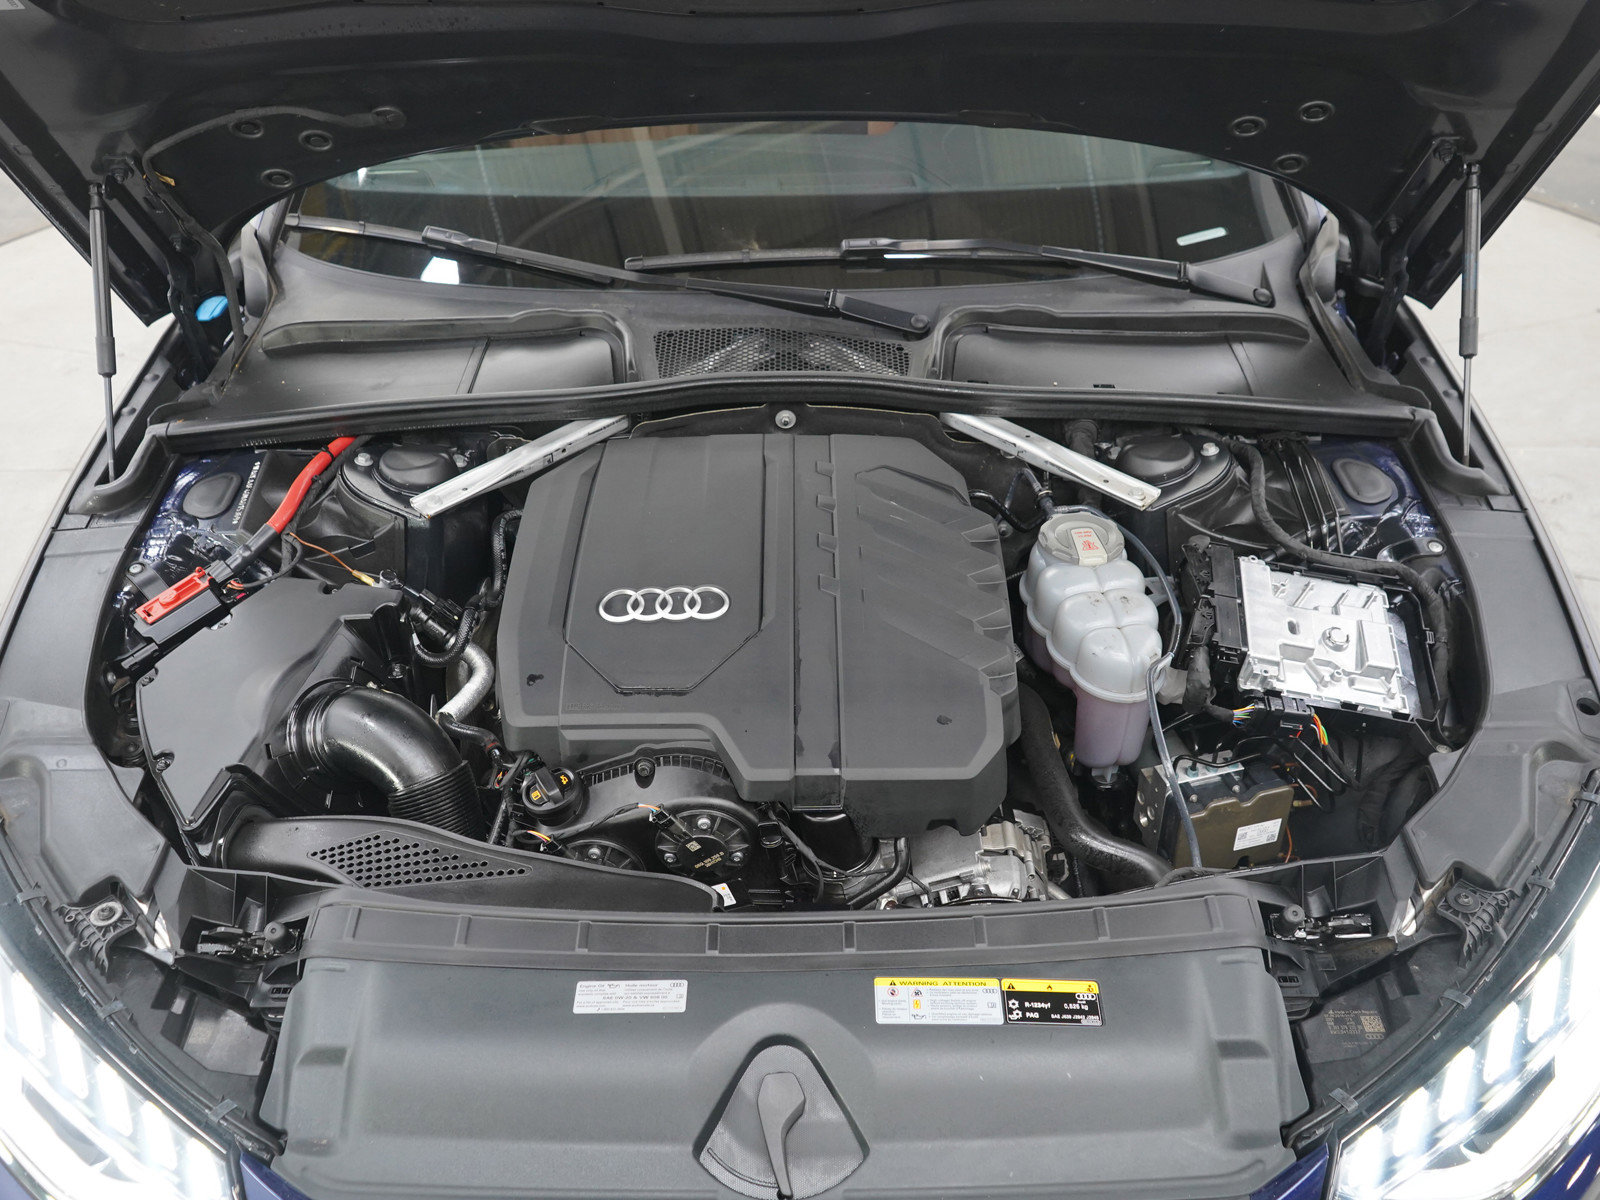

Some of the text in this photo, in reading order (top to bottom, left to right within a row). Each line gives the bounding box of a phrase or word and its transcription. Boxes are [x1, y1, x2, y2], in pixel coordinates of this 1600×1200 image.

[1024, 1001, 1051, 1009] R-1234yf
[1080, 1003, 1089, 1011] kg
[1025, 1011, 1040, 1019] PAG
